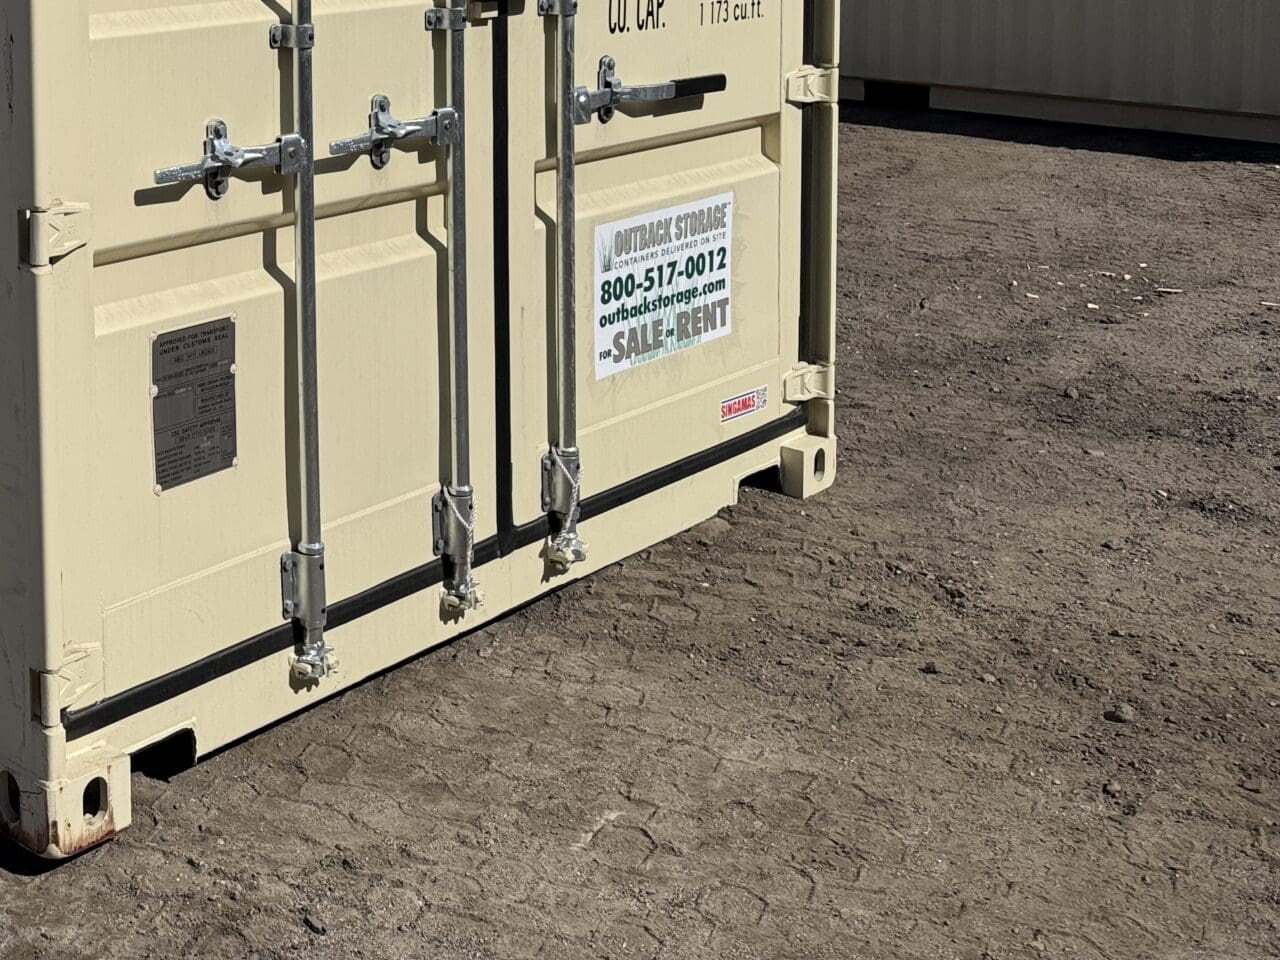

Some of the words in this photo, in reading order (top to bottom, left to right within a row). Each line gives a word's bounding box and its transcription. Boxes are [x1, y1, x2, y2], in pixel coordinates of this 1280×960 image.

[711, 0, 729, 24] 173
[614, 218, 673, 258] OUTBACK
[674, 204, 727, 242] STORAGE
[614, 251, 658, 269] CONTAINERS
[661, 240, 697, 256] DELIVERED
[701, 237, 710, 245] ON
[712, 231, 727, 243] SITE
[601, 246, 727, 305] 800-517-0012
[599, 278, 726, 328] outbackstorage.com
[599, 348, 612, 361] FOR
[612, 318, 663, 364] SALE
[665, 327, 675, 338] OR
[676, 297, 730, 343] RENT
[721, 394, 756, 418] SINGAMAS
